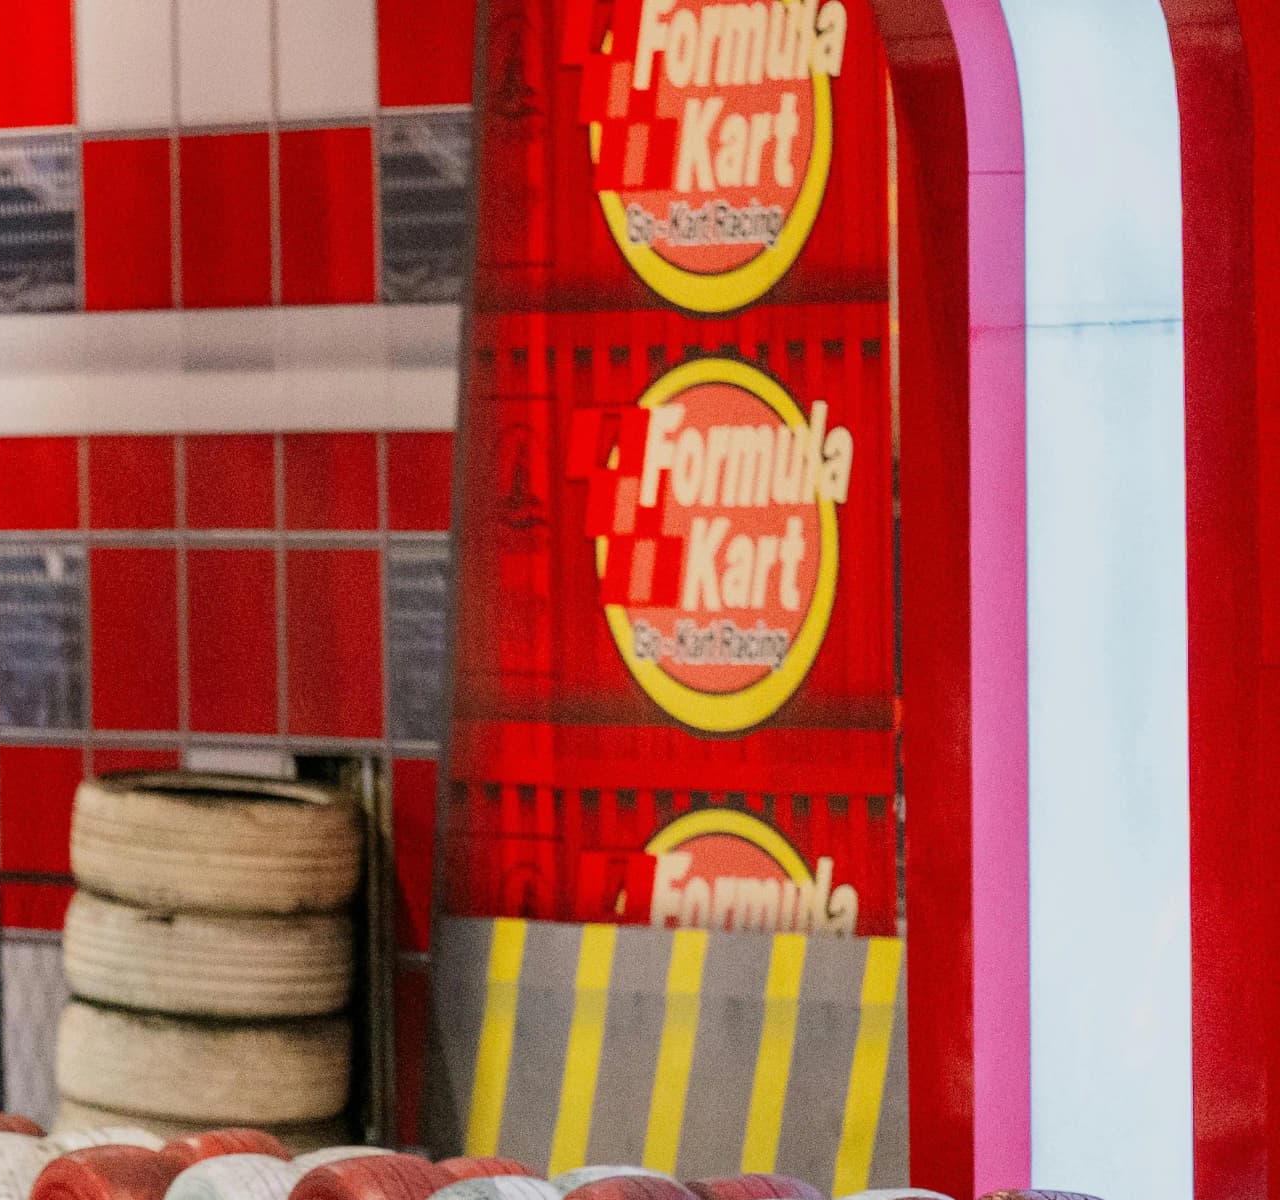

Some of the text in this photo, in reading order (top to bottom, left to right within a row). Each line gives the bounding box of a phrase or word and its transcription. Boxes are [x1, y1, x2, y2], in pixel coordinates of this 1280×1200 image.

[633, 0, 847, 90] Formula
[675, 91, 799, 193] Kart
[713, 199, 785, 248] Racing
[639, 399, 853, 508] Formula
[681, 516, 805, 611] Kart
[718, 618, 791, 671] Racing
[650, 850, 859, 937] Formula
